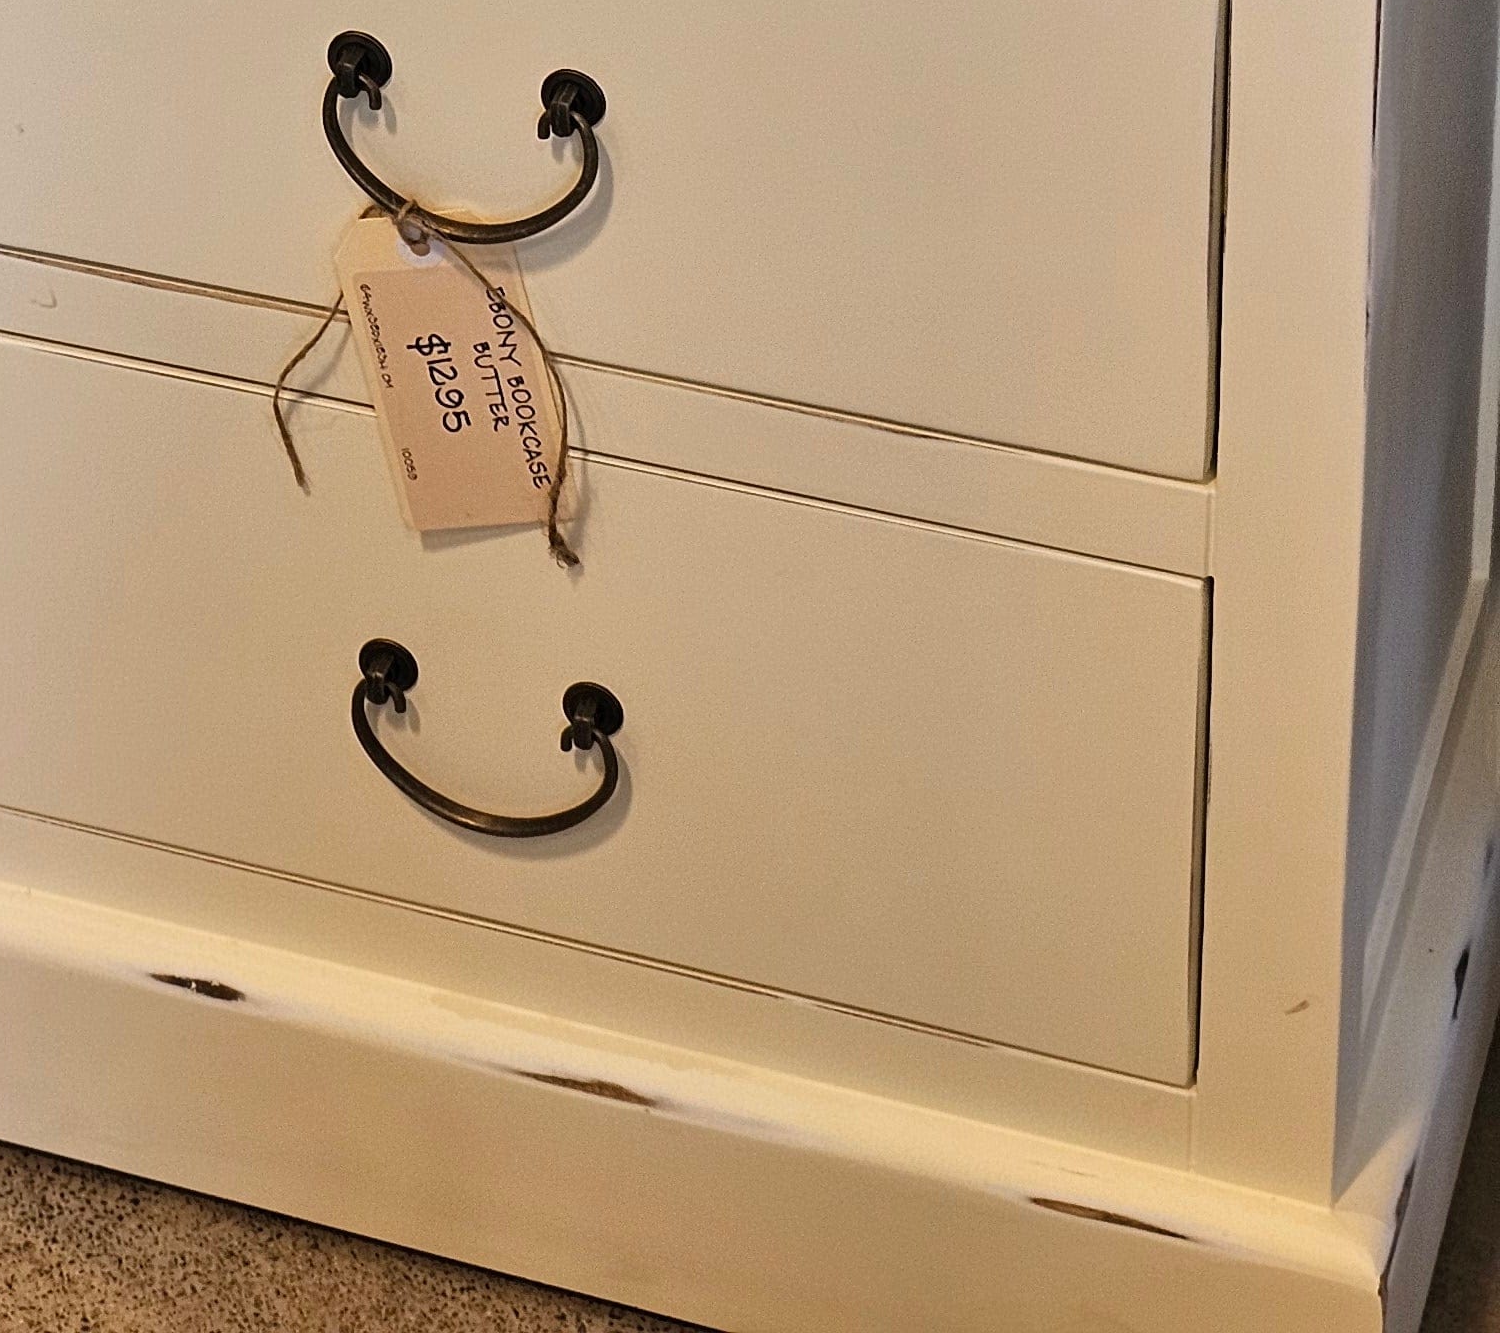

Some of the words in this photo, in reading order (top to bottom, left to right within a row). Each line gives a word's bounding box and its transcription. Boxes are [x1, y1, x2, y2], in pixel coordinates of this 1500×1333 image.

[406, 333, 472, 433] $1295
[473, 341, 510, 432] BUTTER
[485, 286, 522, 367] EBONY
[506, 374, 551, 489] BOOKCASE
